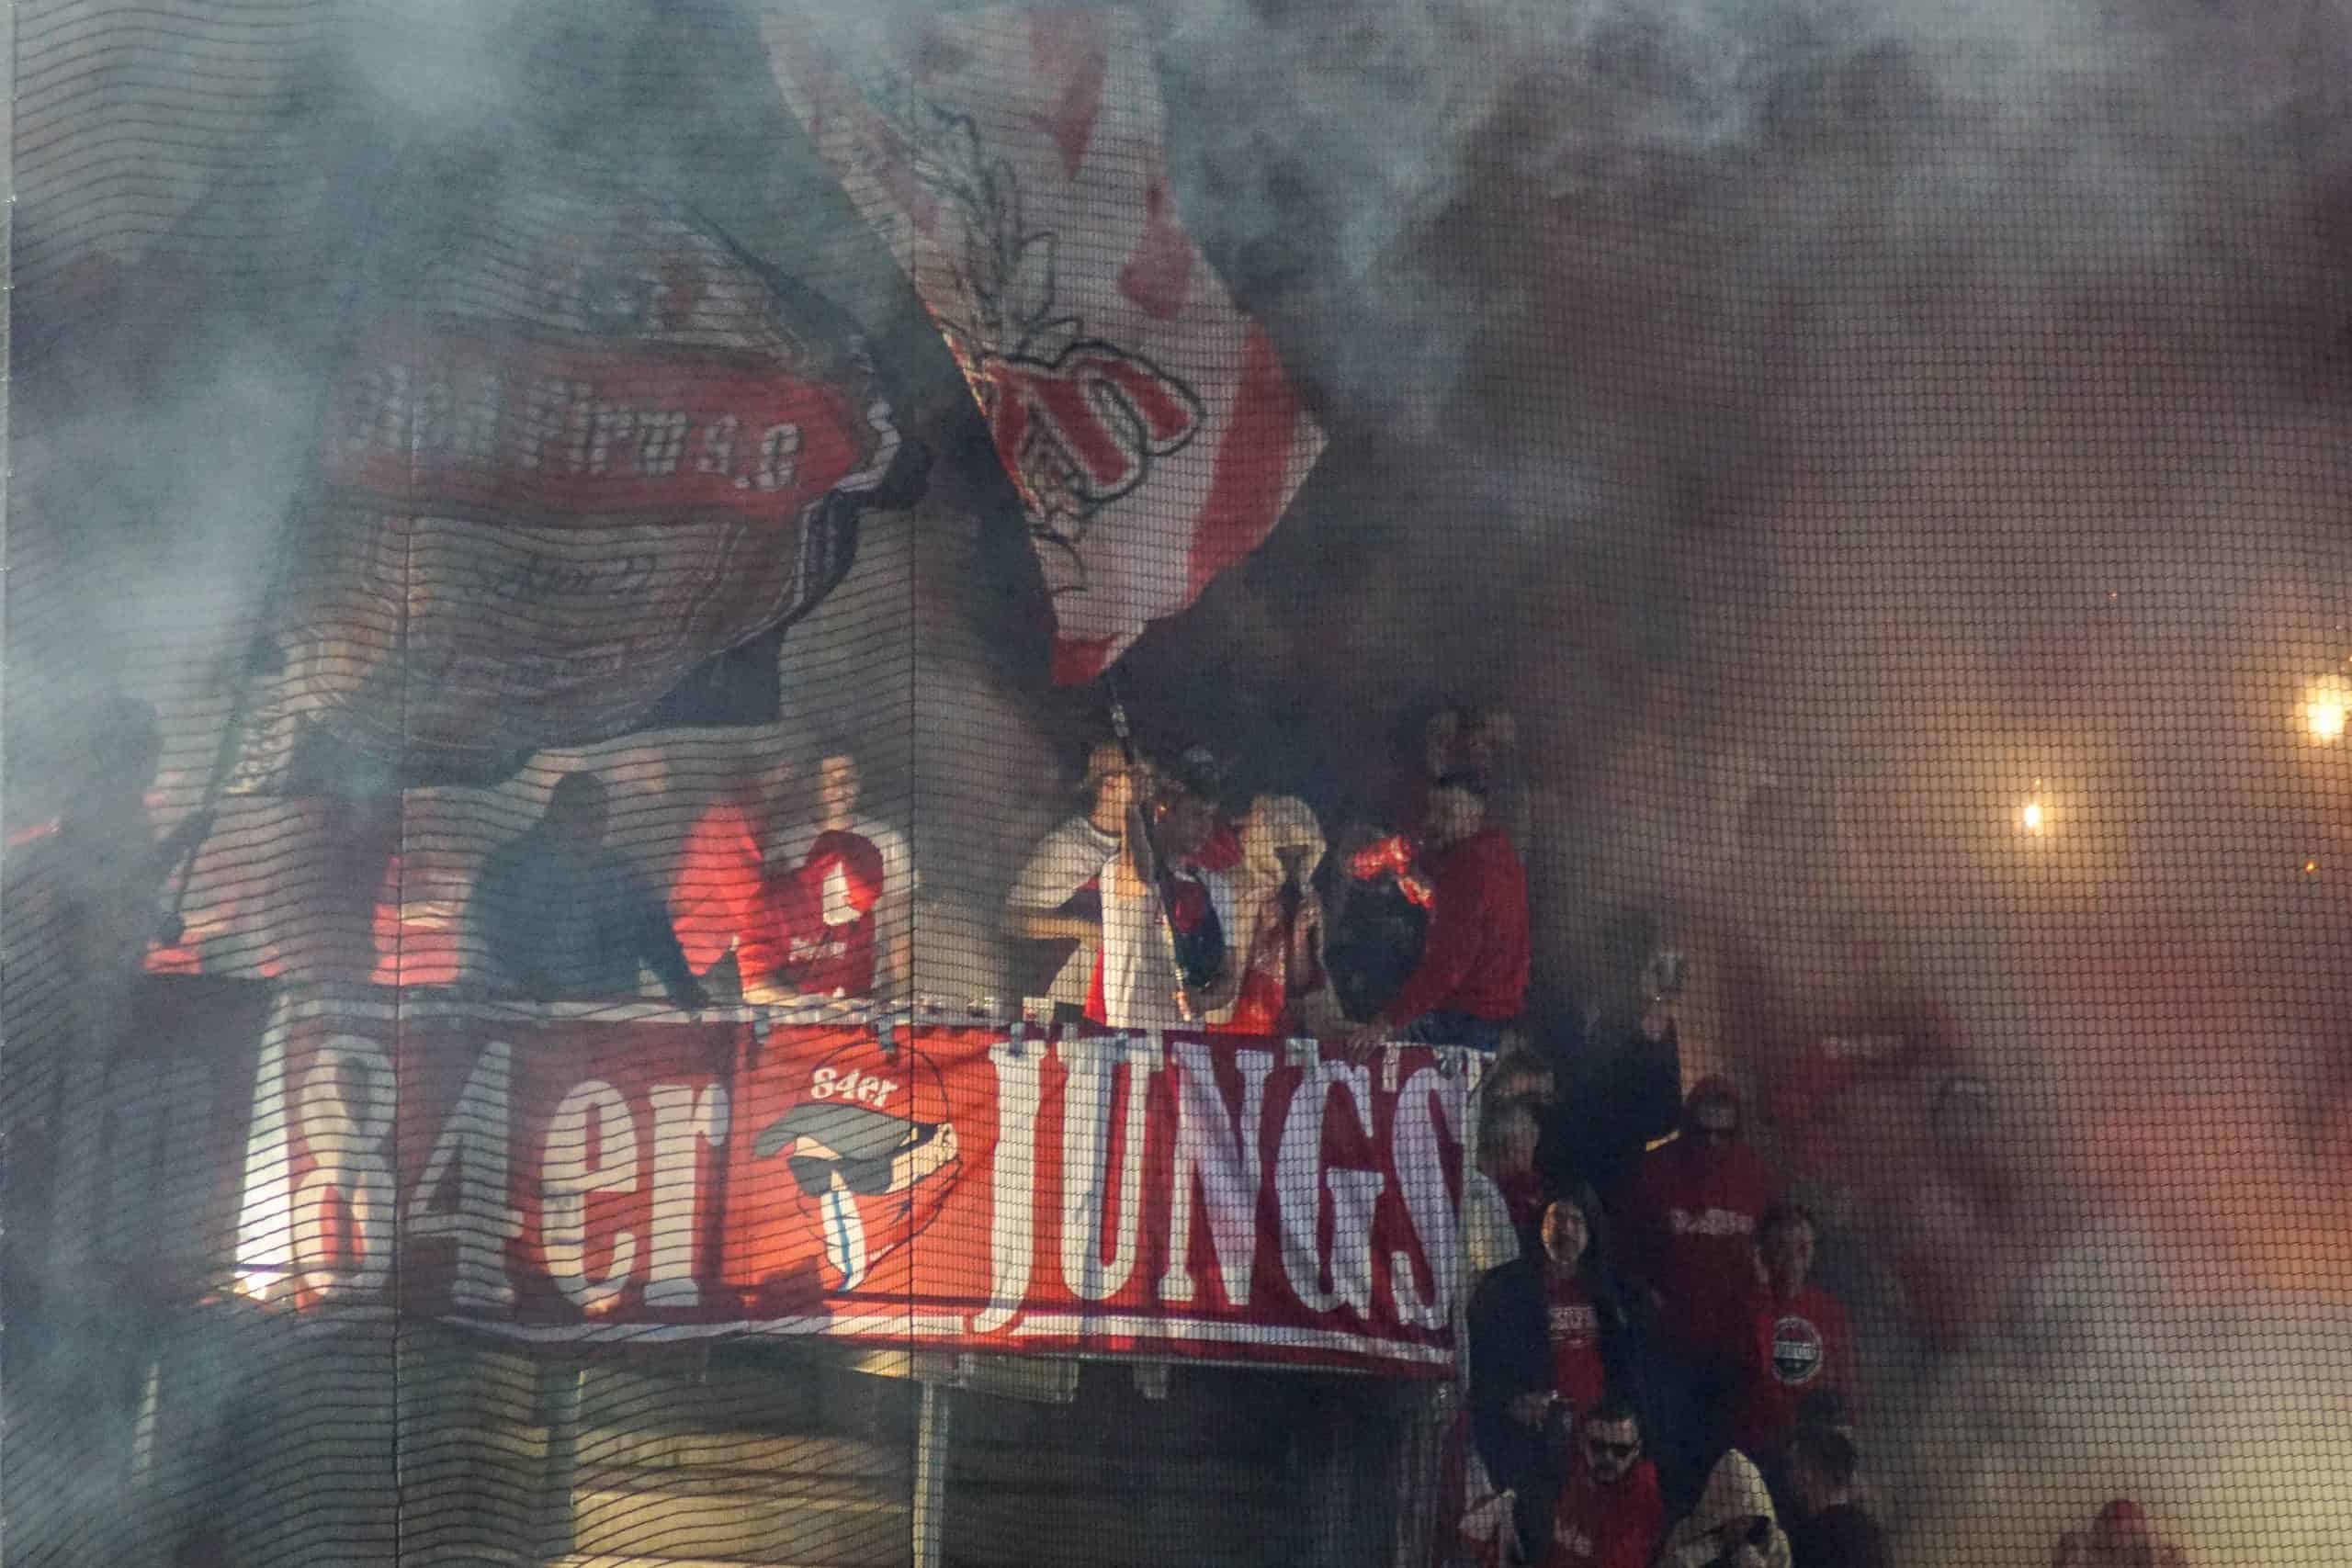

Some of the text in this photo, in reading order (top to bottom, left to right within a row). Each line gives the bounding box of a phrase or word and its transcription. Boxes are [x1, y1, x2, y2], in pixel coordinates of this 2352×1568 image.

[810, 1066, 899, 1108] 84er
[291, 1033, 1467, 1335] 84er JUNGS
